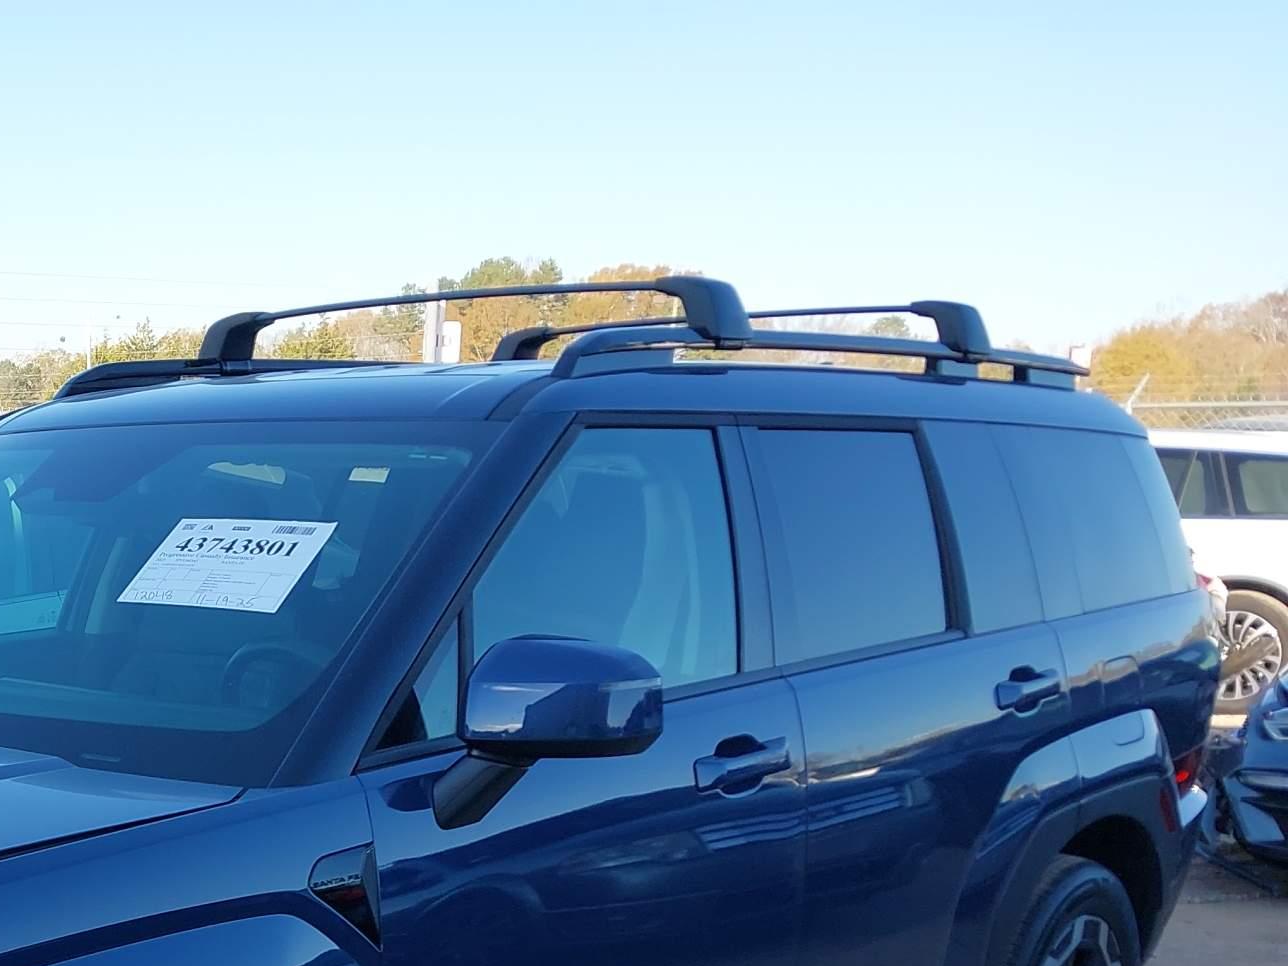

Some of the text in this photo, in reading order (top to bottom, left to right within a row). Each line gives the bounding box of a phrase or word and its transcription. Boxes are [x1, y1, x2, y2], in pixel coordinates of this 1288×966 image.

[175, 536, 300, 557] 43743801
[195, 592, 257, 608] 11-19-25
[312, 876, 346, 889] SANTA
